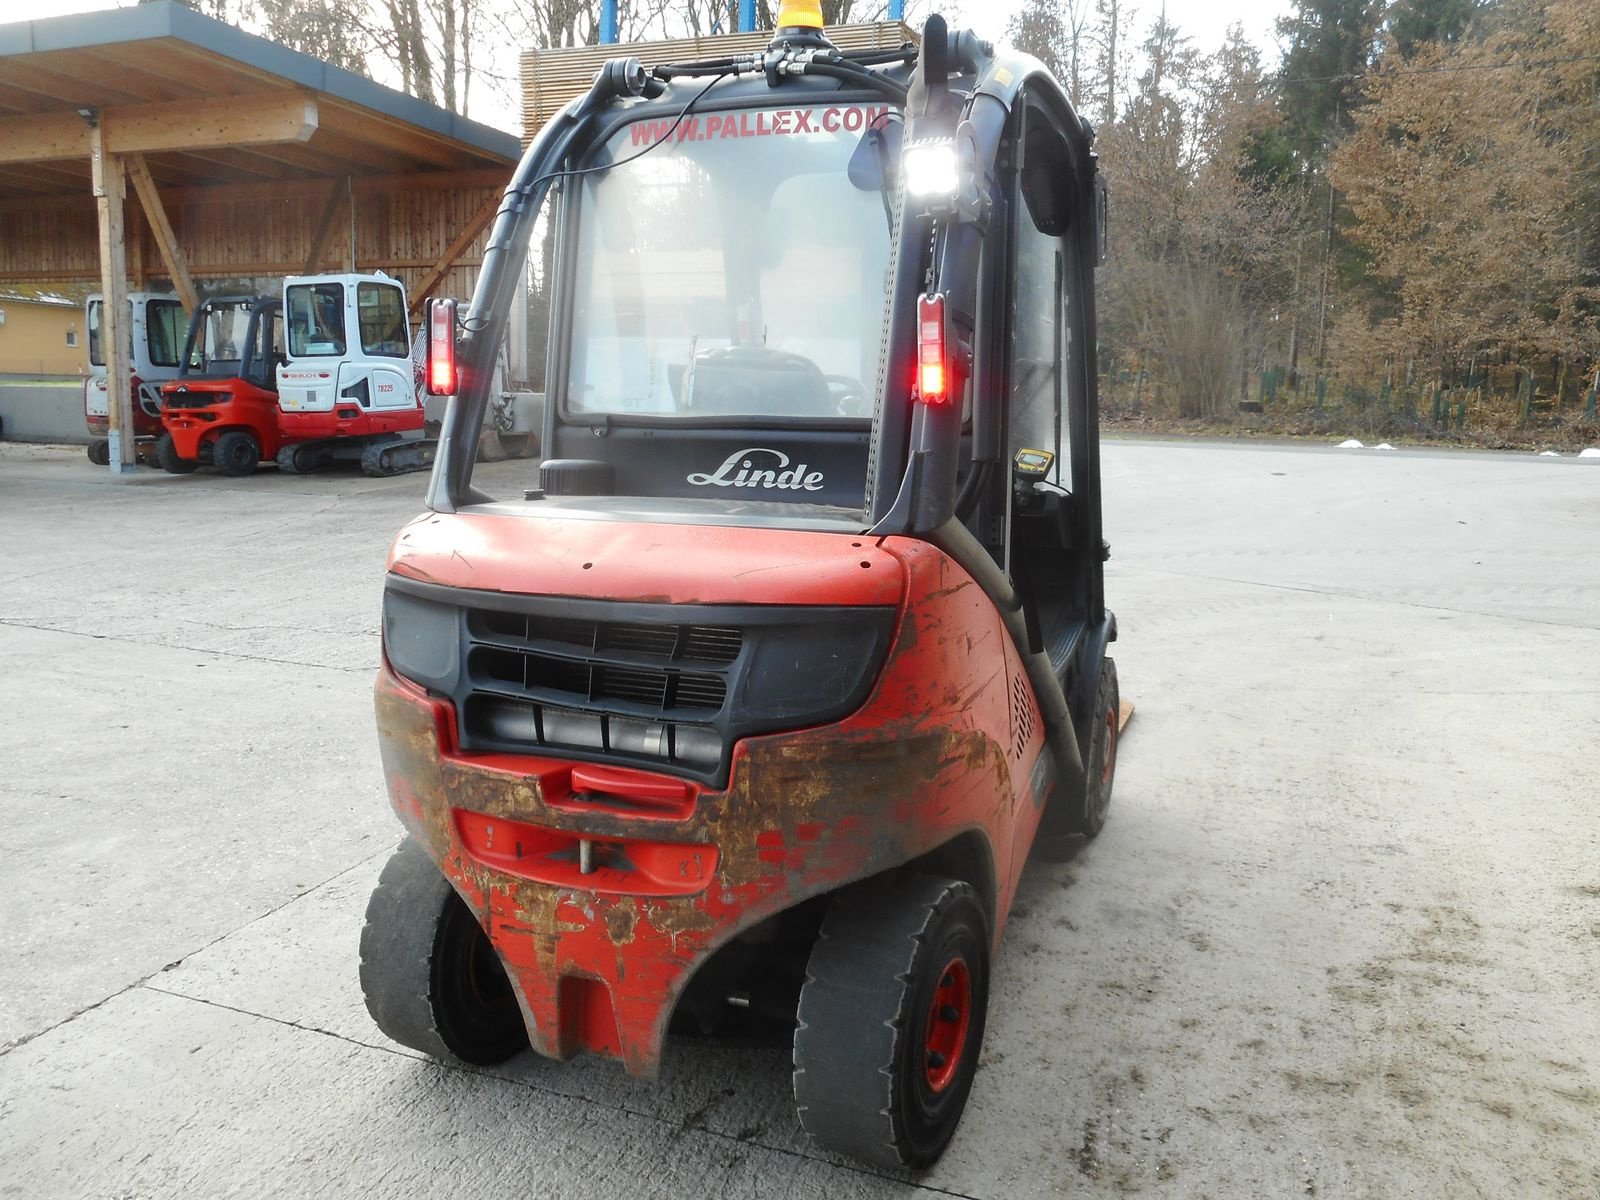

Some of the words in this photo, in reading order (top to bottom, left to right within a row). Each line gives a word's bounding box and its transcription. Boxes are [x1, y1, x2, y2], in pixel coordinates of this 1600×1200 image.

[630, 105, 889, 146] WWW.PALLEX.COM
[377, 384, 394, 393] TB225
[687, 448, 824, 491] Linde
